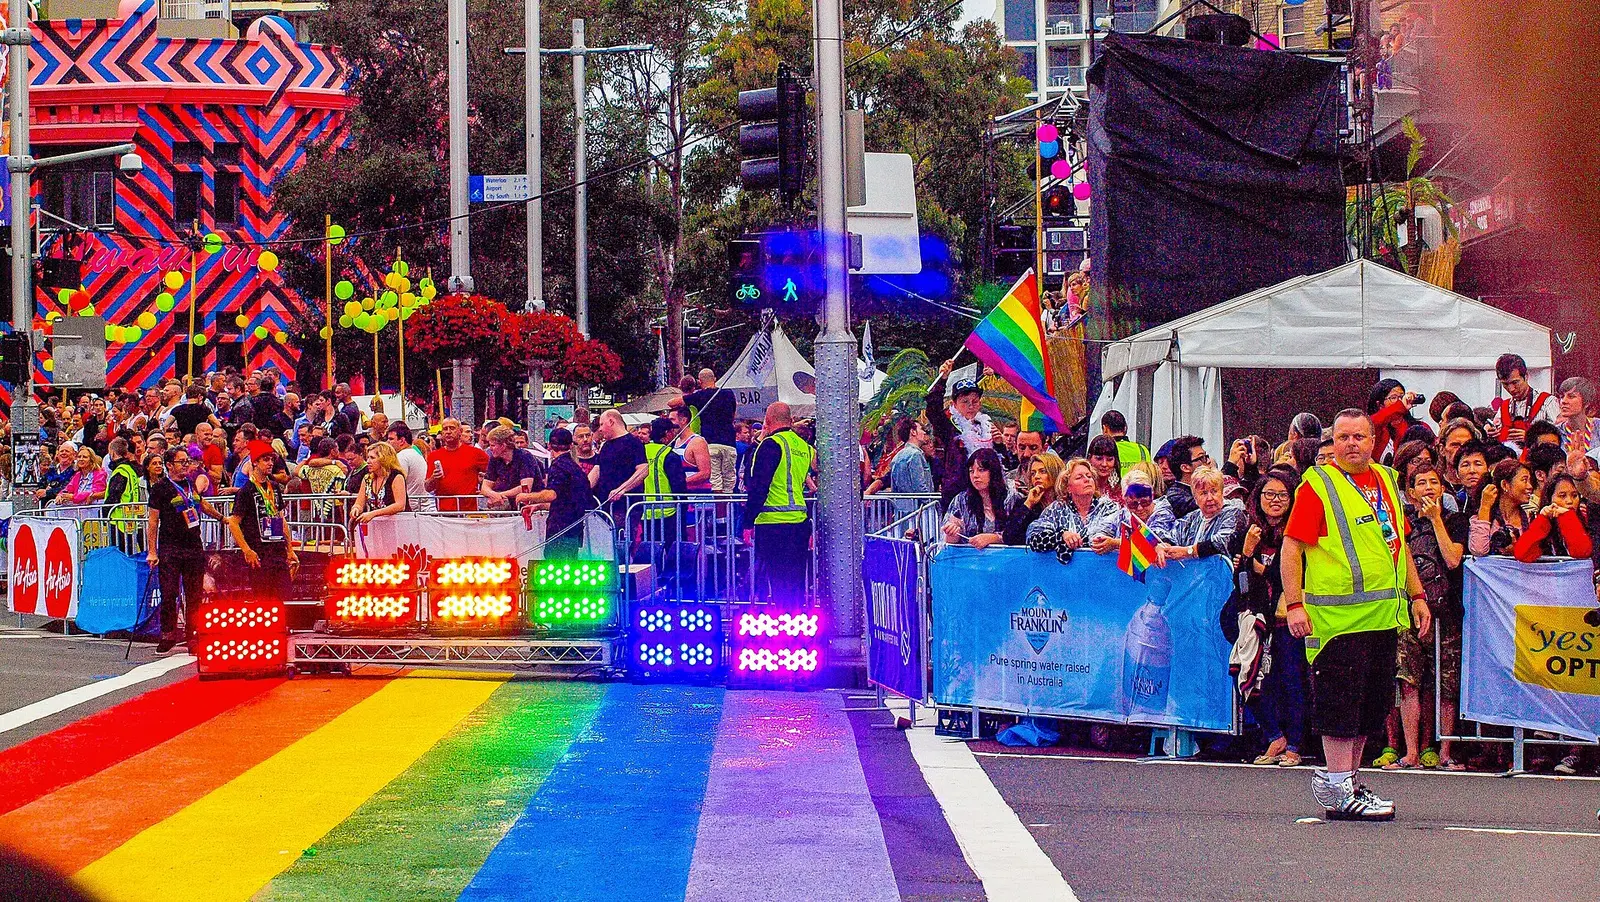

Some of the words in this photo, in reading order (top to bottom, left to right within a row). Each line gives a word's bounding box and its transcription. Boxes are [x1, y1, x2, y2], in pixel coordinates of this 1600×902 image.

[740, 390, 761, 405] BAR
[1021, 607, 1053, 619] MOUNT
[1010, 612, 1065, 634] FRANKLIN
[989, 653, 1009, 667] Pure
[1010, 657, 1037, 672] spring
[1039, 660, 1063, 671] water
[1065, 661, 1090, 674] raised
[1017, 673, 1025, 685] in
[1027, 674, 1063, 688] Australia
